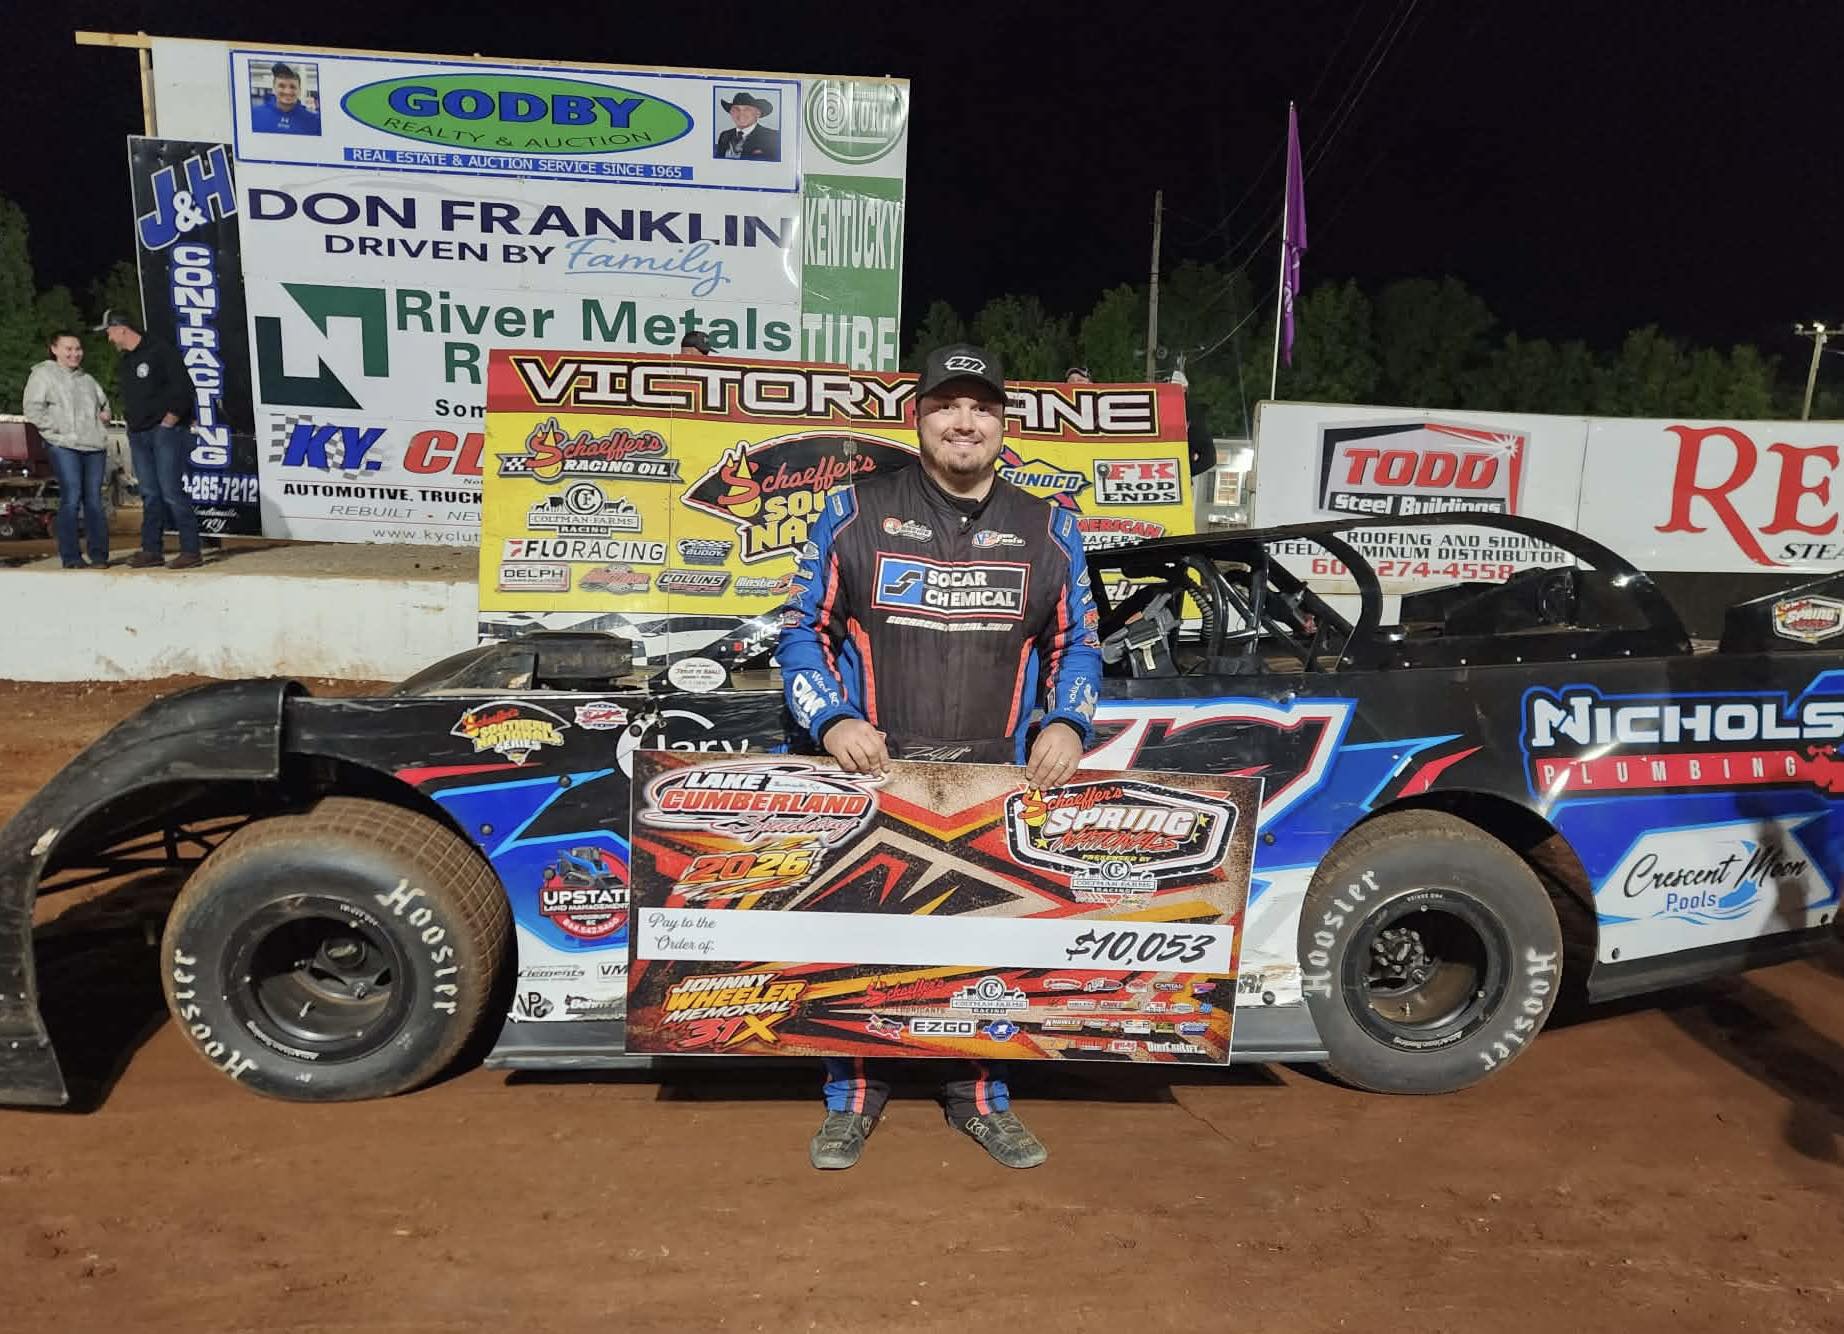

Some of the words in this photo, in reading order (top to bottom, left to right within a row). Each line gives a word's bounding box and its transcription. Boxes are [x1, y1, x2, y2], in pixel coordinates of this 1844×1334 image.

[388, 86, 645, 129] GODBY
[383, 117, 485, 143] REALTY
[496, 136, 512, 147] &
[524, 130, 652, 147] AUCTION
[353, 149, 391, 162] REAL
[396, 152, 449, 166] ESTATE
[452, 154, 463, 166] &
[468, 155, 533, 170] AUCTION
[538, 159, 597, 174] SERVICE
[602, 162, 645, 176] SINCE
[650, 165, 682, 178] 1965
[248, 188, 416, 229] DON
[440, 199, 791, 248] FRANKLIN
[804, 197, 900, 270] KENTUCKY
[325, 234, 487, 261] DRIVEN
[503, 245, 555, 265] BY
[564, 237, 731, 297] Family
[396, 288, 555, 339] River
[582, 299, 792, 352] Metals
[173, 246, 229, 465] CONTRACTING
[512, 357, 918, 422] VICTORY
[1004, 387, 1158, 435] ANE
[525, 424, 665, 468] Schaeffer's
[564, 458, 633, 473] RACING
[637, 461, 669, 476] OIL
[1109, 463, 1175, 481] FK
[1344, 447, 1499, 490] TODD
[718, 455, 877, 506] Schaeffer's
[1002, 470, 1079, 490] SUNOCO
[1114, 482, 1176, 492] ROD
[1102, 491, 1176, 502] ENDS
[1334, 494, 1394, 515] Steel
[329, 505, 418, 519] REBUILT
[593, 516, 637, 526] FARMS
[561, 526, 608, 535] RACING
[1347, 530, 1432, 547] ROOFING
[1441, 534, 1481, 548] AND
[525, 540, 665, 560] FLORACING
[1438, 548, 1566, 564] DISTRIBUTOR
[504, 568, 563, 579] DELPH
[659, 573, 724, 586] COLLINS
[927, 571, 988, 587] SOCAR
[925, 589, 1015, 607] CHEMICAL
[480, 719, 553, 738] SOUTHERN
[1532, 696, 1844, 747] NICHOLS
[476, 730, 564, 752] NATIONALS
[685, 771, 767, 791] LAKE
[1543, 755, 1797, 785] PLUMBING
[659, 790, 871, 818] CUMBERLAND
[1018, 786, 1124, 820] Schaeffer's
[732, 813, 861, 843] Speedway
[1044, 805, 1199, 836] SPRING
[683, 851, 813, 885] 2026
[1082, 853, 1137, 862] PRESENTED
[1623, 851, 1735, 898] Crescent
[1733, 848, 1807, 889] Moon
[568, 902, 630, 911] MANAGEMENT
[1666, 891, 1716, 912] Pools
[648, 912, 678, 931] Pay
[681, 917, 694, 928] to
[696, 916, 716, 929] the
[1065, 929, 1216, 965] $10,053
[671, 973, 776, 994] JOHNNY
[666, 982, 806, 1012] WHEELER
[665, 1000, 791, 1025] MEMORIAL
[676, 1013, 788, 1050] 31X
